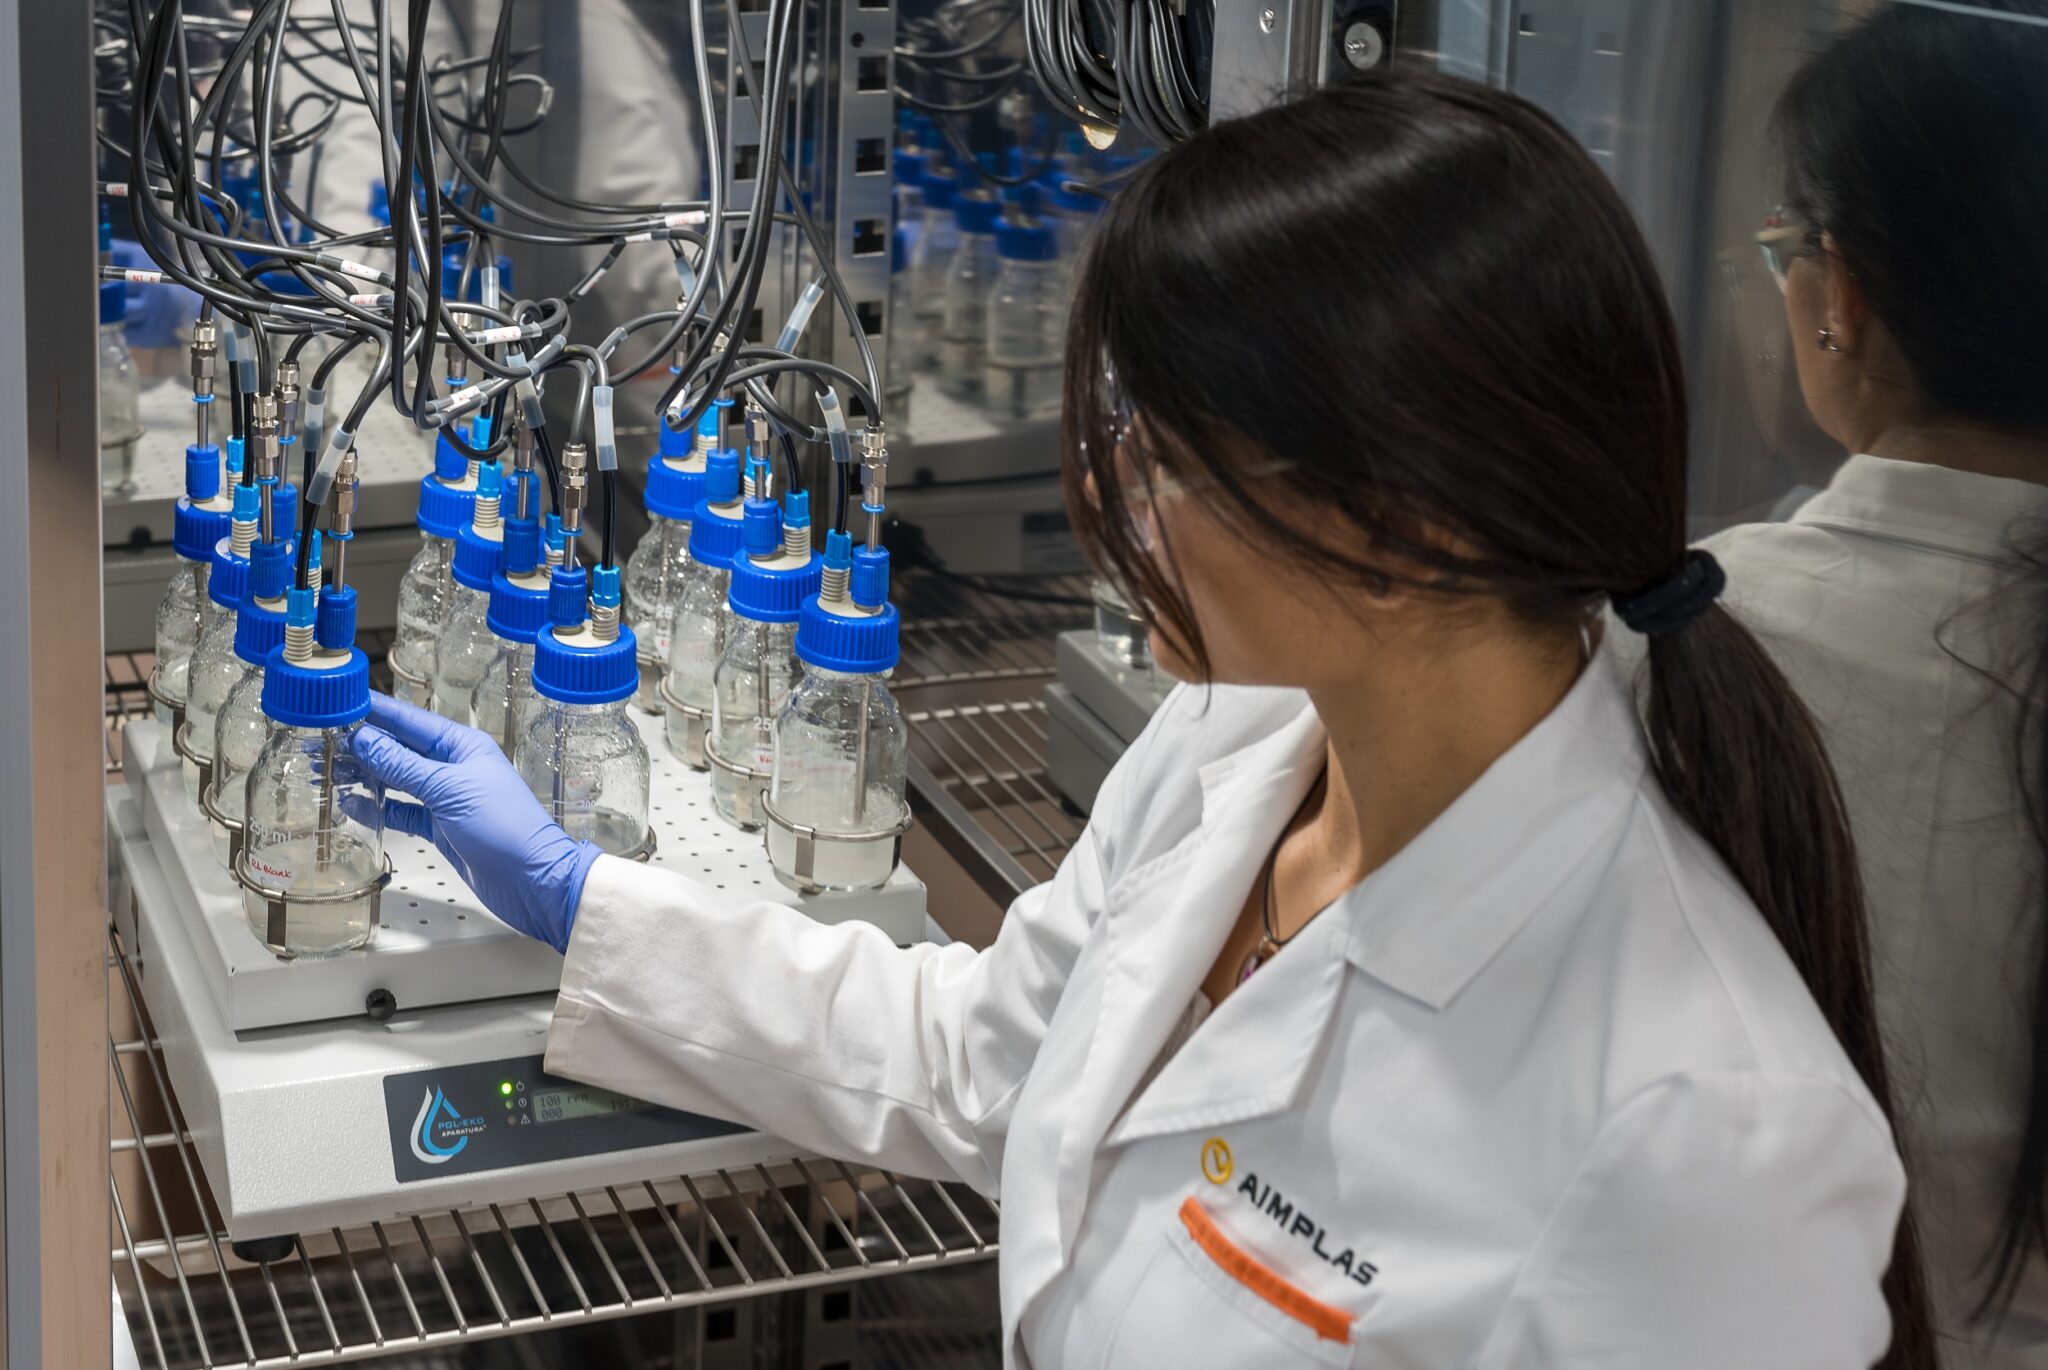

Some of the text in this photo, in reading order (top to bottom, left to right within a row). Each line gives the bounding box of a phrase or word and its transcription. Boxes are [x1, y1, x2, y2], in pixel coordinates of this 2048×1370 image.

[753, 716, 772, 732] 25
[540, 1095, 561, 1108] 100
[541, 1107, 563, 1121] 000
[1237, 1171, 1379, 1287] AIMPLAS
